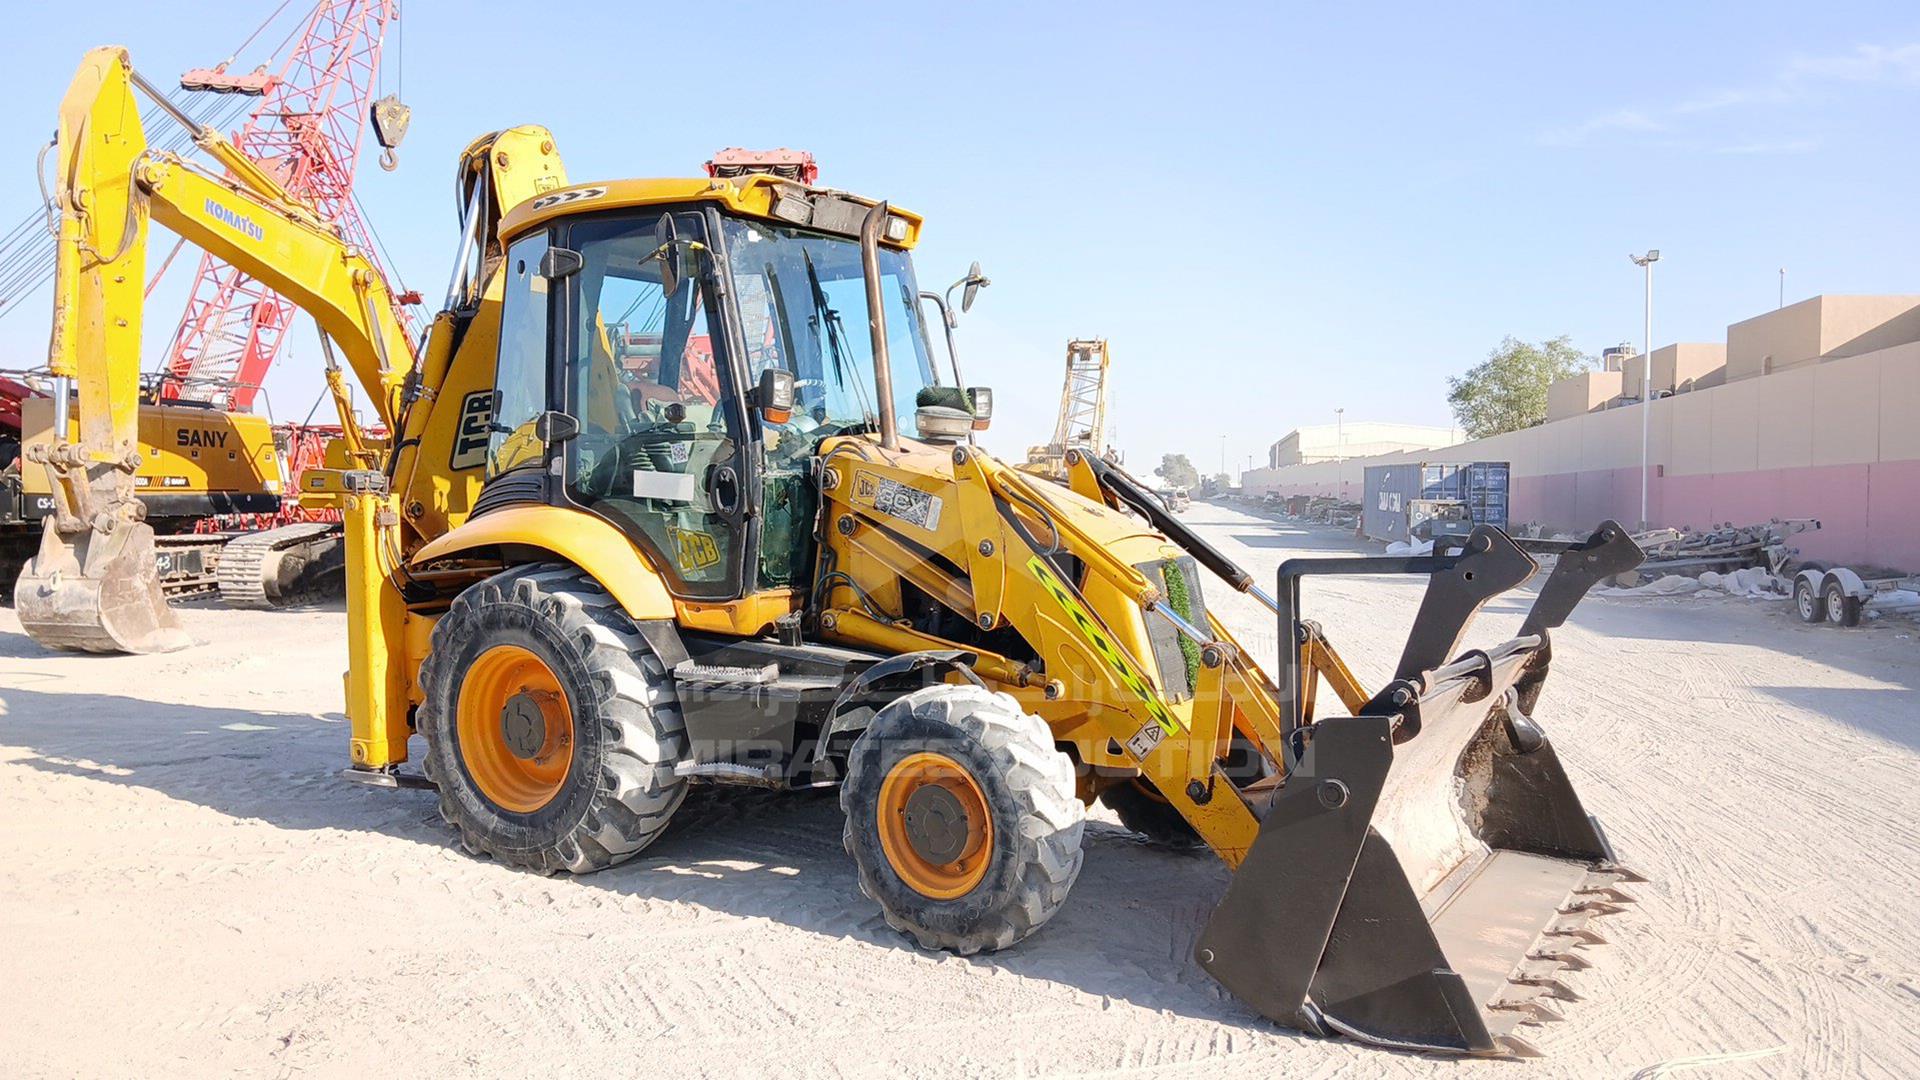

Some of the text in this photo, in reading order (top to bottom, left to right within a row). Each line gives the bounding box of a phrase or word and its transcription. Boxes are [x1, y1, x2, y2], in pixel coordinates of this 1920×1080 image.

[205, 199, 263, 240] KOMATSU
[177, 429, 228, 448] SANY
[678, 532, 718, 568] JCB
